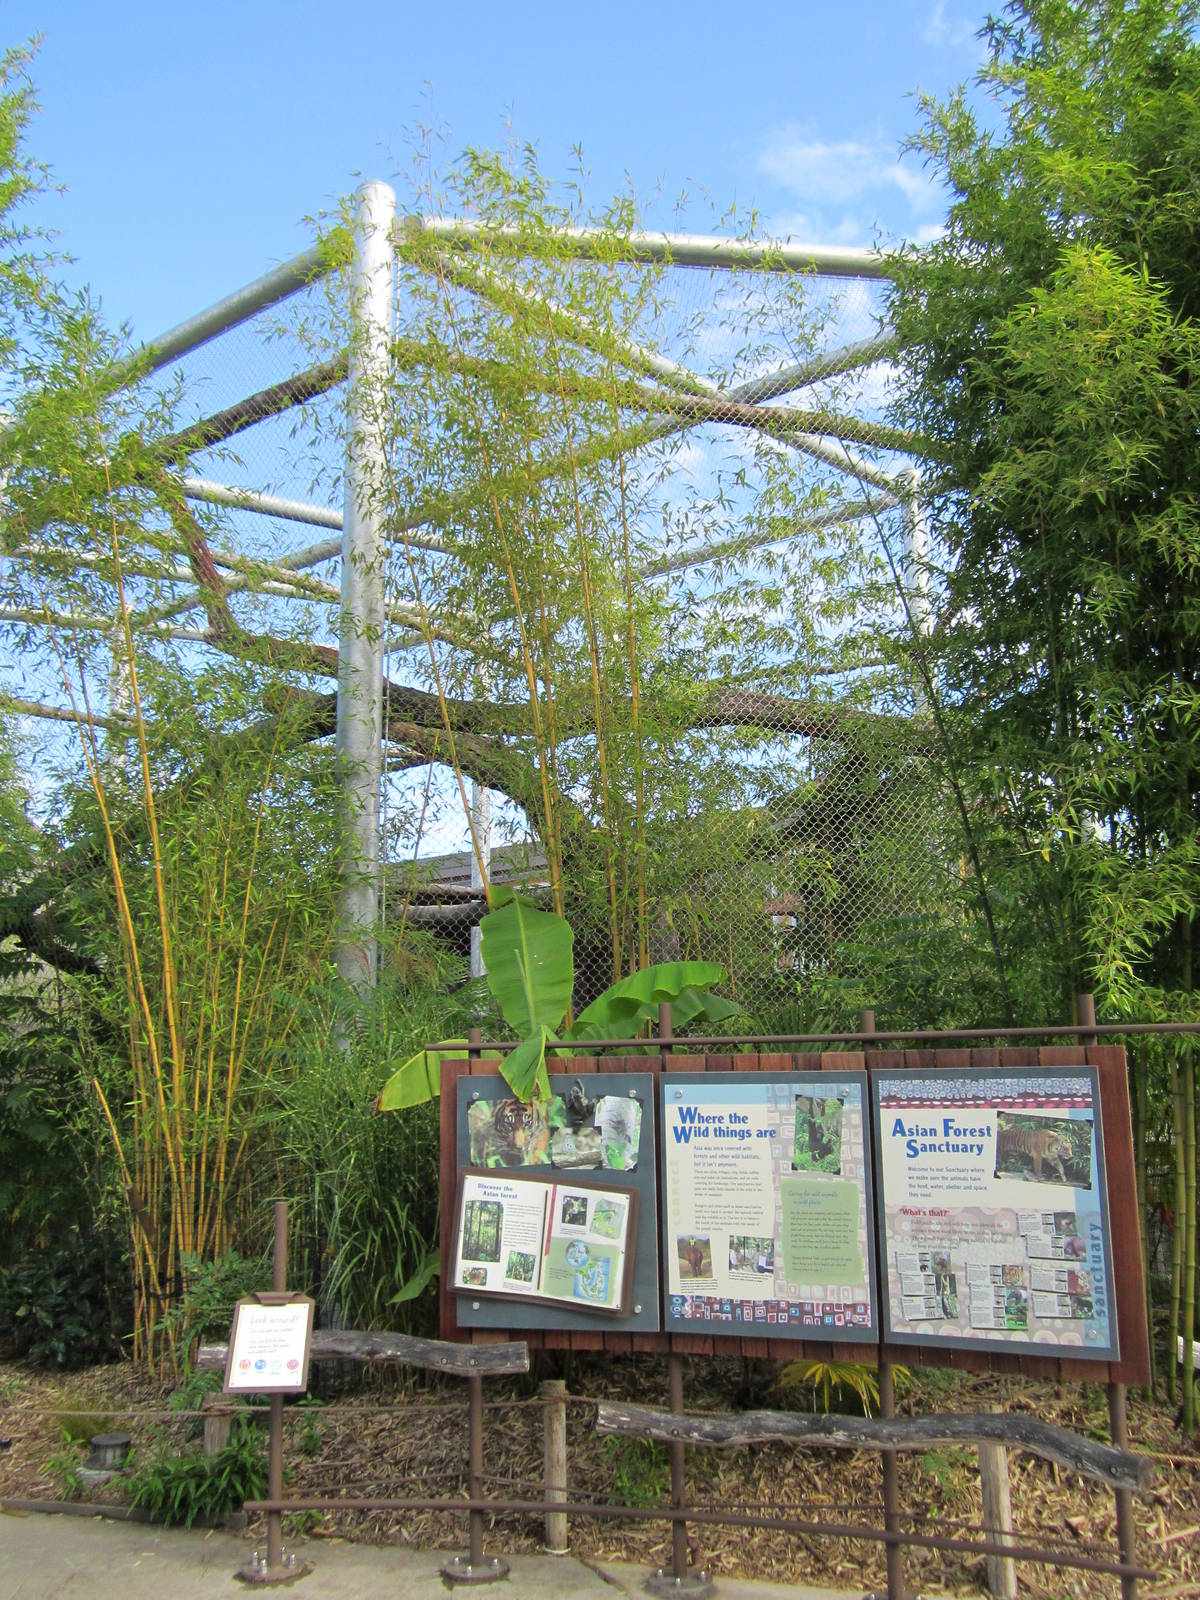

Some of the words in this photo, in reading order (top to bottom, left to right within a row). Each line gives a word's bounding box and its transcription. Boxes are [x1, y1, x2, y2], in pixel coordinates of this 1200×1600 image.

[677, 1106, 725, 1124] Where
[728, 1112, 749, 1124] the
[672, 1126, 709, 1144] Wild
[713, 1126, 752, 1140] things
[756, 1129, 777, 1138] are
[891, 1118, 938, 1137] Asian
[943, 1118, 992, 1137] Forest
[906, 1139, 984, 1158] Sanctuary
[477, 1183, 502, 1191] Discover
[482, 1190, 499, 1198] Asian
[1089, 1223, 1106, 1318] sanctuary
